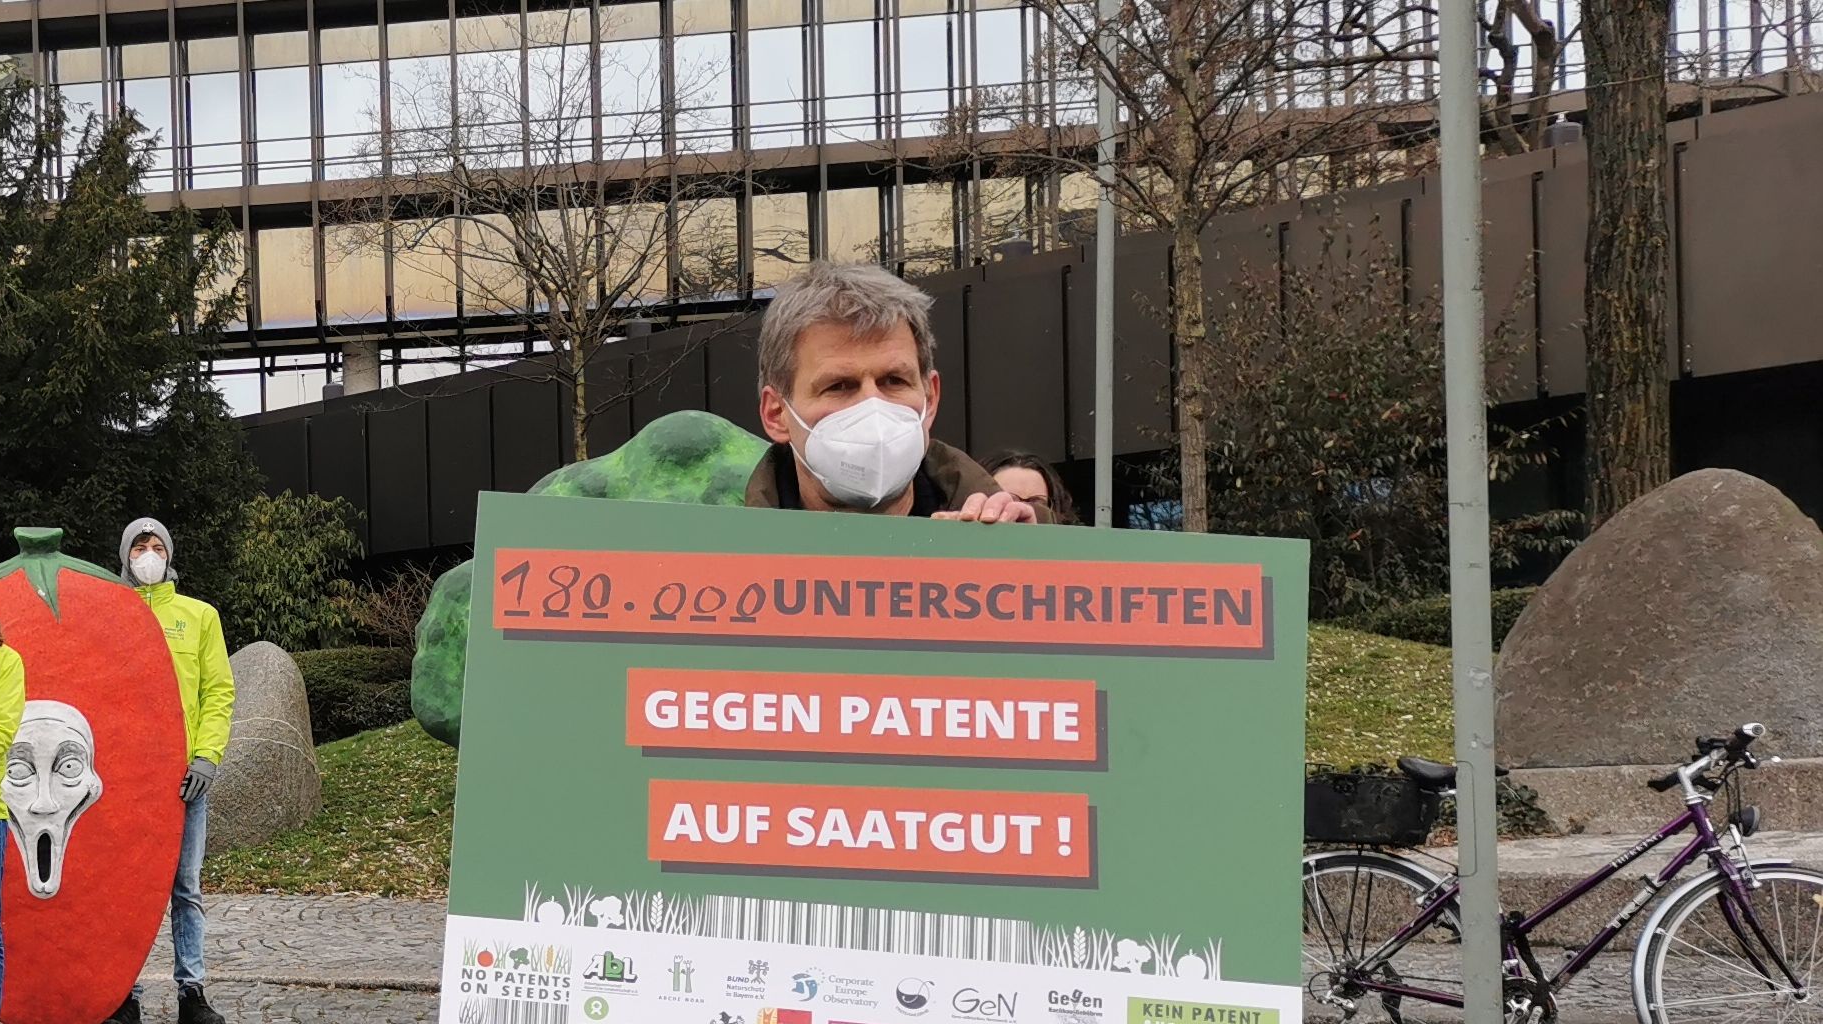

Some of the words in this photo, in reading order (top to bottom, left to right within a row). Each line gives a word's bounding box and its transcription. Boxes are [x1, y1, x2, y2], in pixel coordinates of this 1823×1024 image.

[773, 578, 1253, 626] UNTERSCHRIFTEN
[644, 690, 820, 733] GEGEN
[840, 697, 1079, 742] PATENTE
[663, 803, 770, 844] AUF
[786, 808, 1041, 855] SAATGUT
[461, 968, 487, 981] NO
[494, 970, 571, 988] PATENTS
[727, 975, 750, 984] BUND
[828, 974, 875, 987] Corporate
[460, 981, 488, 995] ON
[501, 985, 570, 1002] SEEDS!
[823, 994, 879, 1009] Observatory
[835, 986, 867, 997] Europe
[1048, 988, 1103, 1009] Gegen
[952, 988, 1018, 1018] GeN
[1143, 1003, 1183, 1020] KEIN
